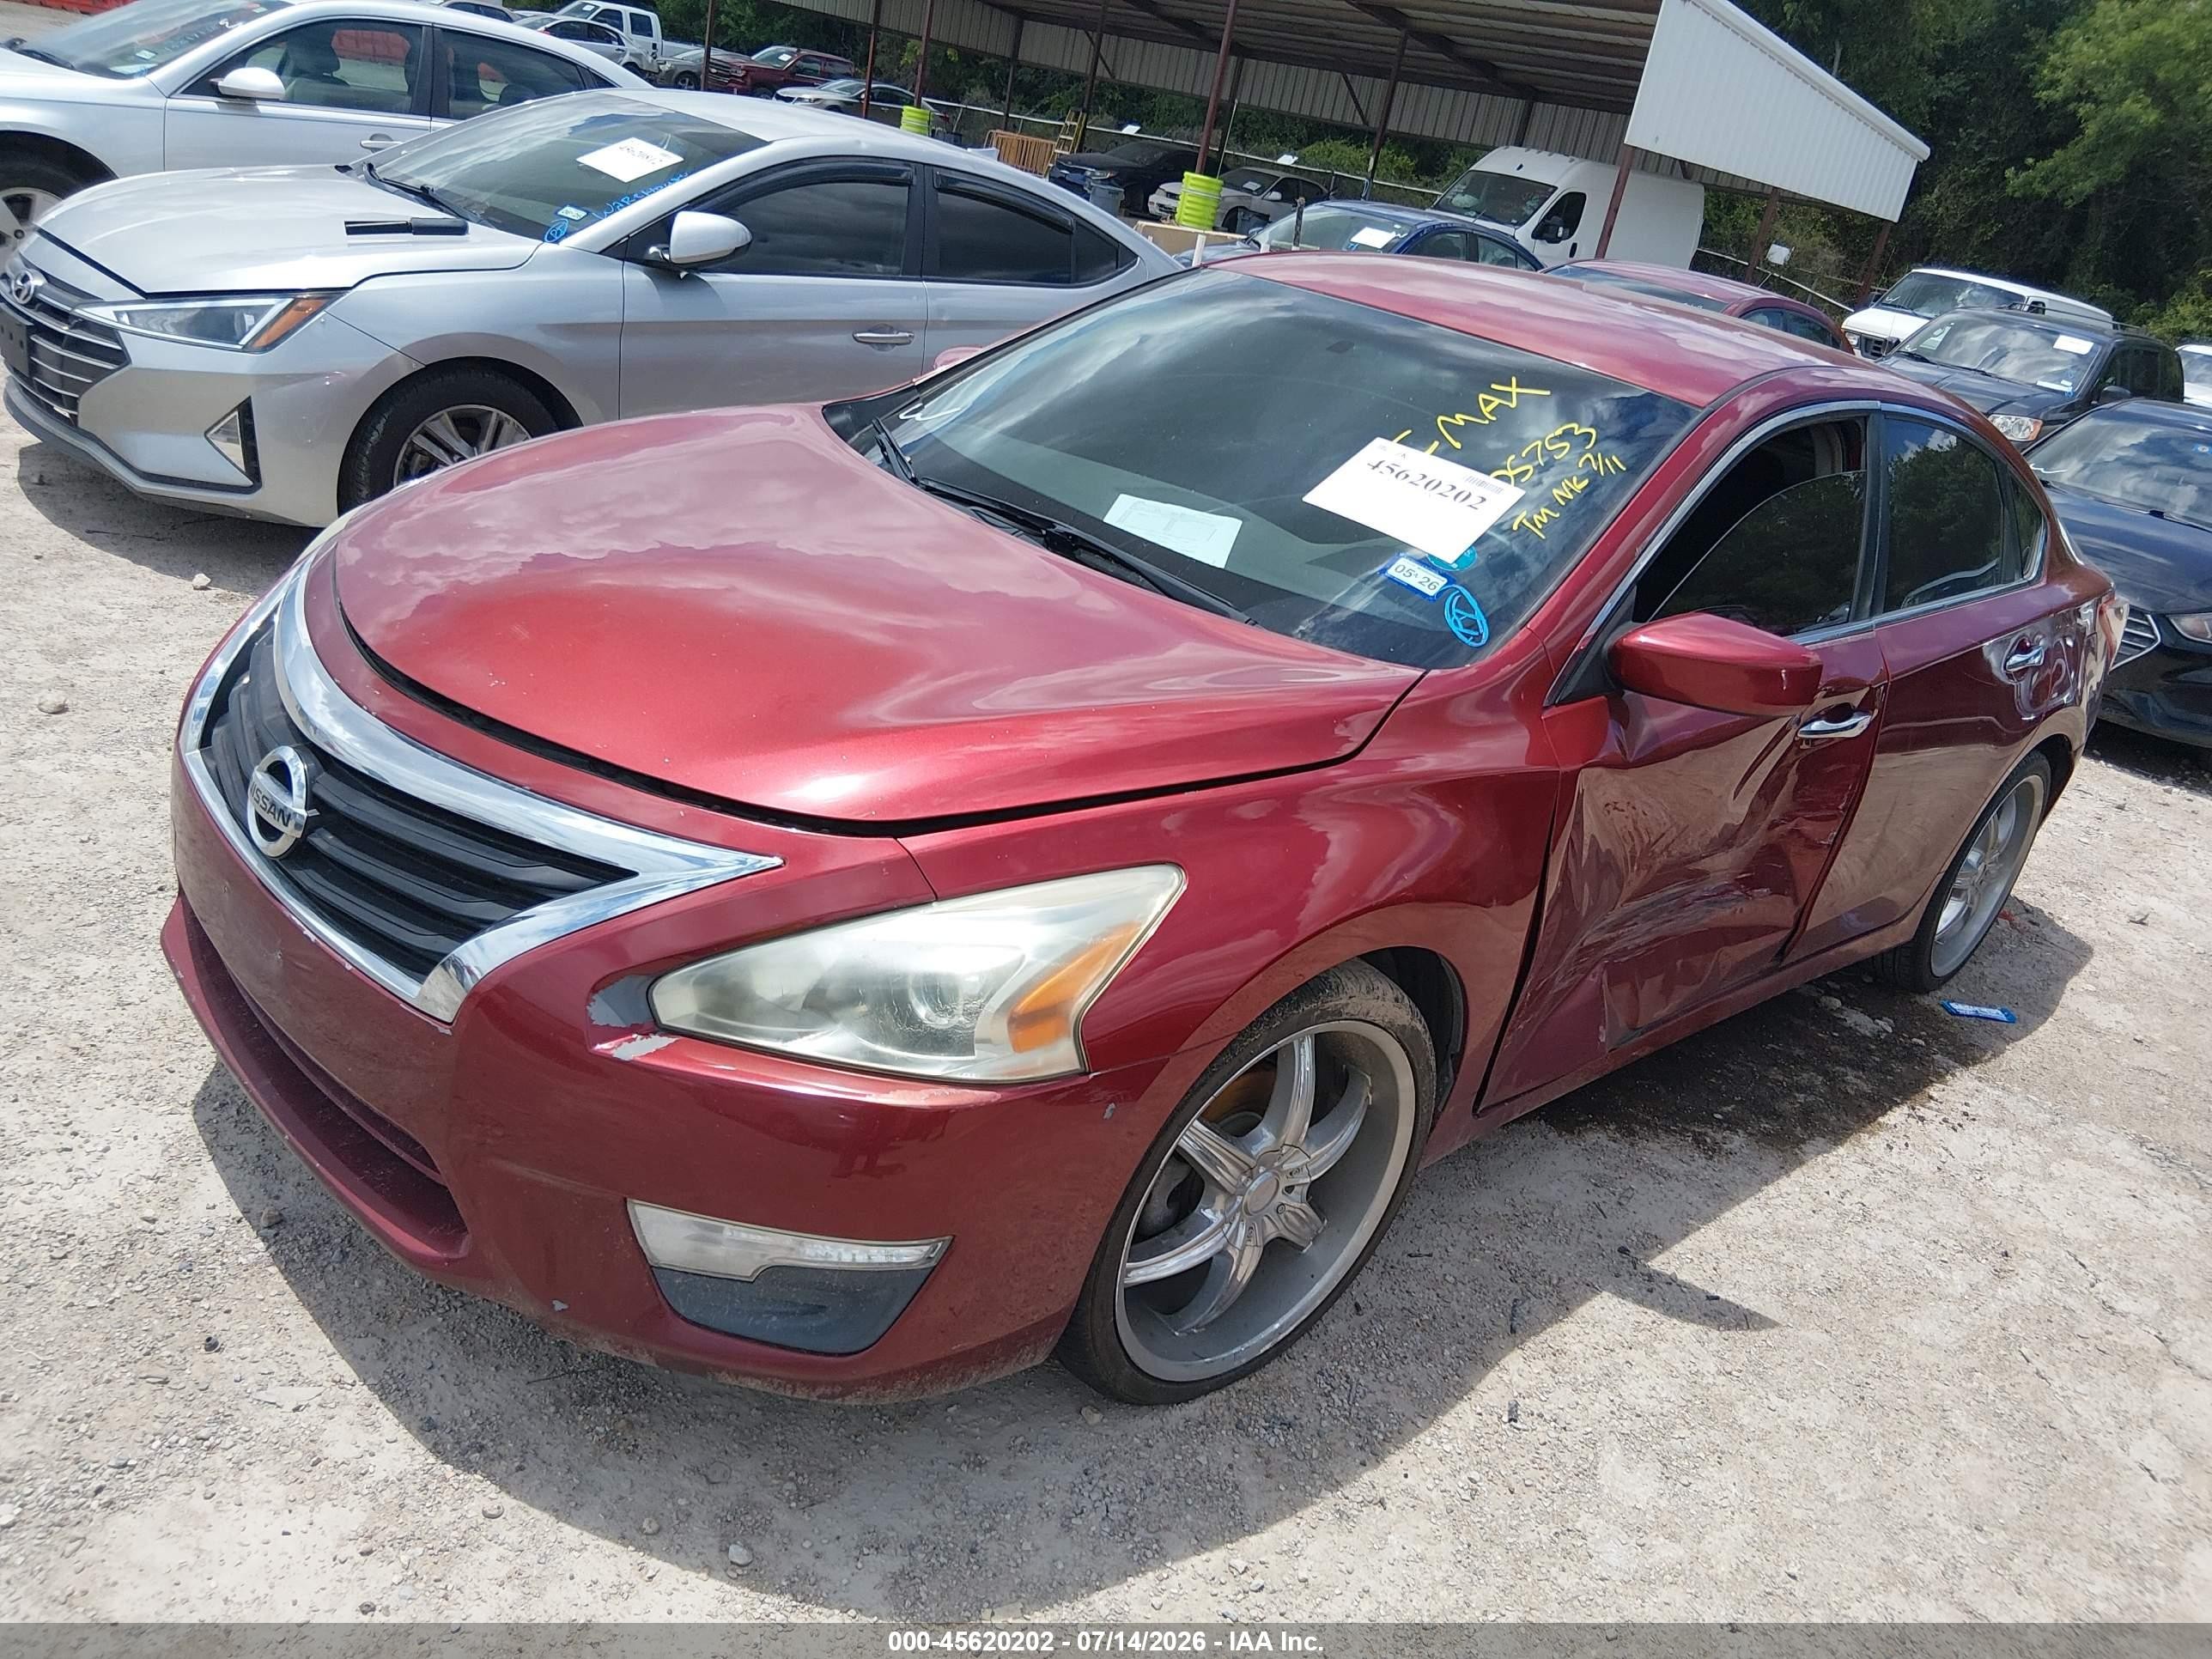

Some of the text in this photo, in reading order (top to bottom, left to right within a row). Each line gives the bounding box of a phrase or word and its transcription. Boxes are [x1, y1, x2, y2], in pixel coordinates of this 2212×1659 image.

[1366, 459, 1487, 510] 45620202
[1394, 563, 1440, 591] 05 26
[250, 781, 292, 828] NISSAN
